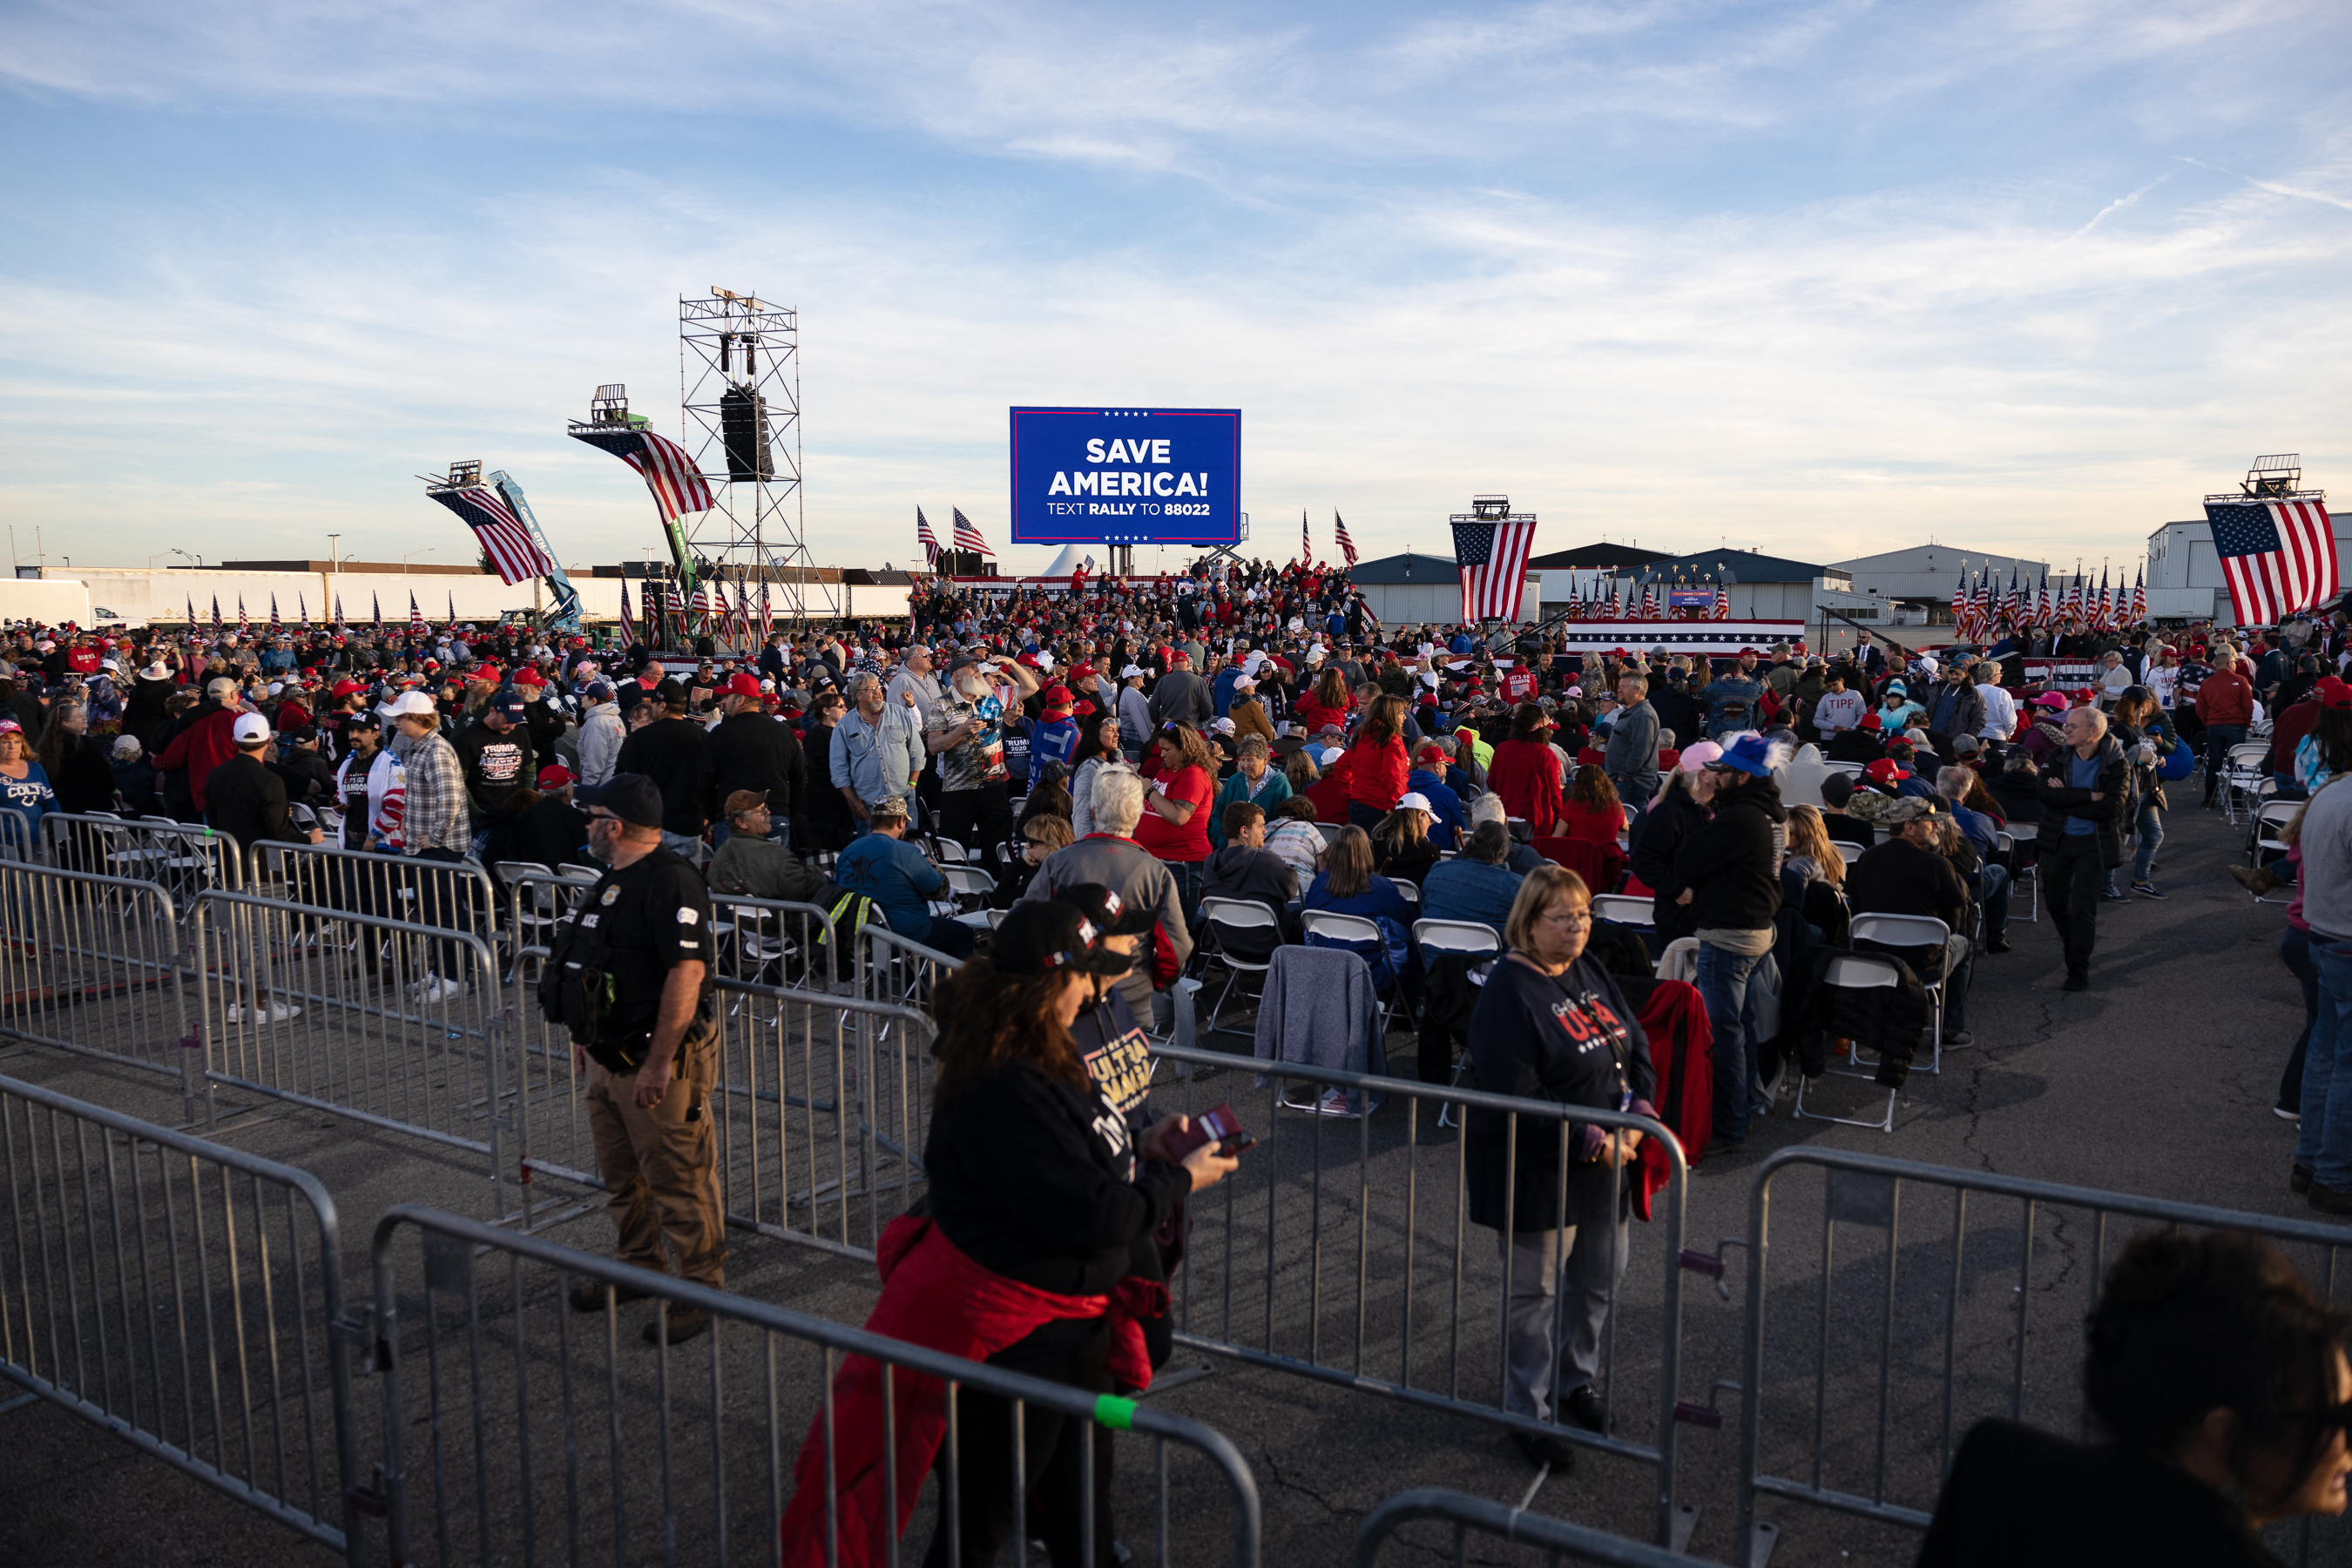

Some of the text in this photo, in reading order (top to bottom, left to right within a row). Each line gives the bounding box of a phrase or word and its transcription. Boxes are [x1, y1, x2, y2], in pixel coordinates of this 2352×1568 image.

[1086, 438, 1171, 463] SAVE
[1048, 471, 1208, 497] AMERICA!
[520, 506, 535, 530] Genie
[1047, 503, 1210, 516] TEXT RALLY TO 88022
[1828, 699, 1855, 709] TIPP
[483, 744, 517, 754] TRUMP
[7, 786, 47, 798] COLTS
[1044, 950, 1073, 969] USA
[1091, 1037, 1148, 1082] ULTRA
